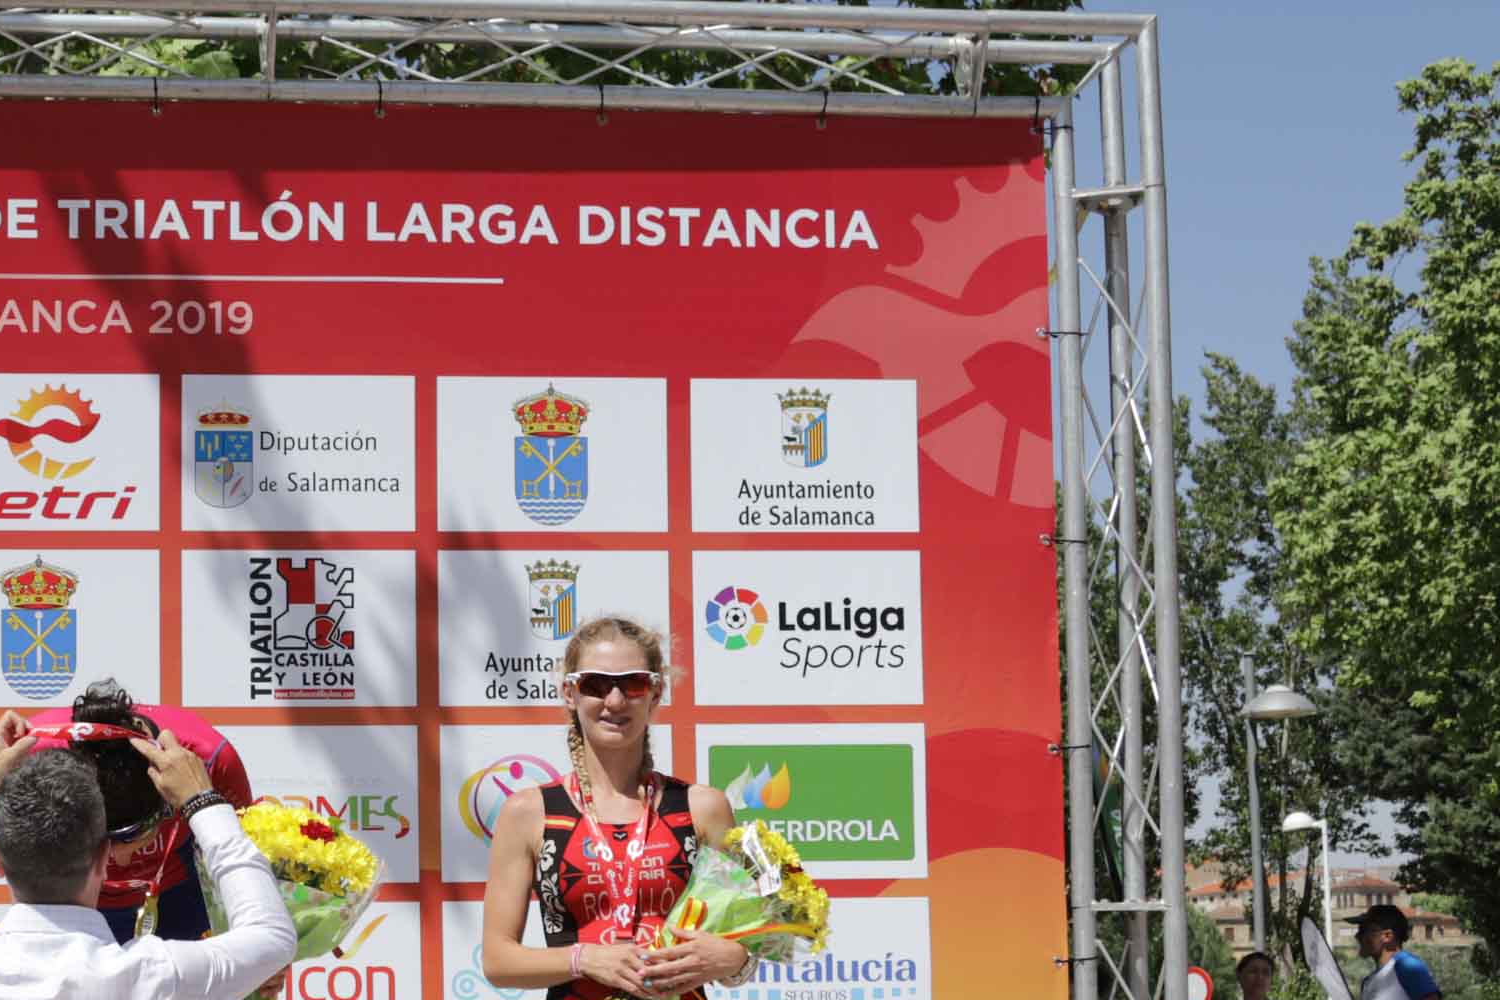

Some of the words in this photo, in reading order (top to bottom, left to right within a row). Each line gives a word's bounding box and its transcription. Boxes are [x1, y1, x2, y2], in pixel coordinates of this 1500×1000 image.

[57, 189, 345, 243] TRIATLÓN
[366, 201, 557, 245] LARGA
[579, 205, 879, 250] DISTANCIA
[148, 300, 254, 335] 2019
[258, 430, 378, 457] Diputación
[258, 475, 279, 493] de
[287, 471, 401, 493] Salamanca
[737, 478, 875, 504] Ayuntamiento
[738, 505, 761, 526] de
[768, 505, 875, 526] Salamanca
[249, 557, 273, 700] TRIATLON
[778, 597, 905, 638] LaLiga
[274, 652, 355, 668] CASTILLA
[779, 637, 905, 677] Sports
[274, 672, 287, 686] Y
[302, 668, 355, 687] LEÓN
[485, 679, 509, 700] de
[769, 819, 900, 843] ERDROLA
[749, 952, 917, 983] ntalucía
